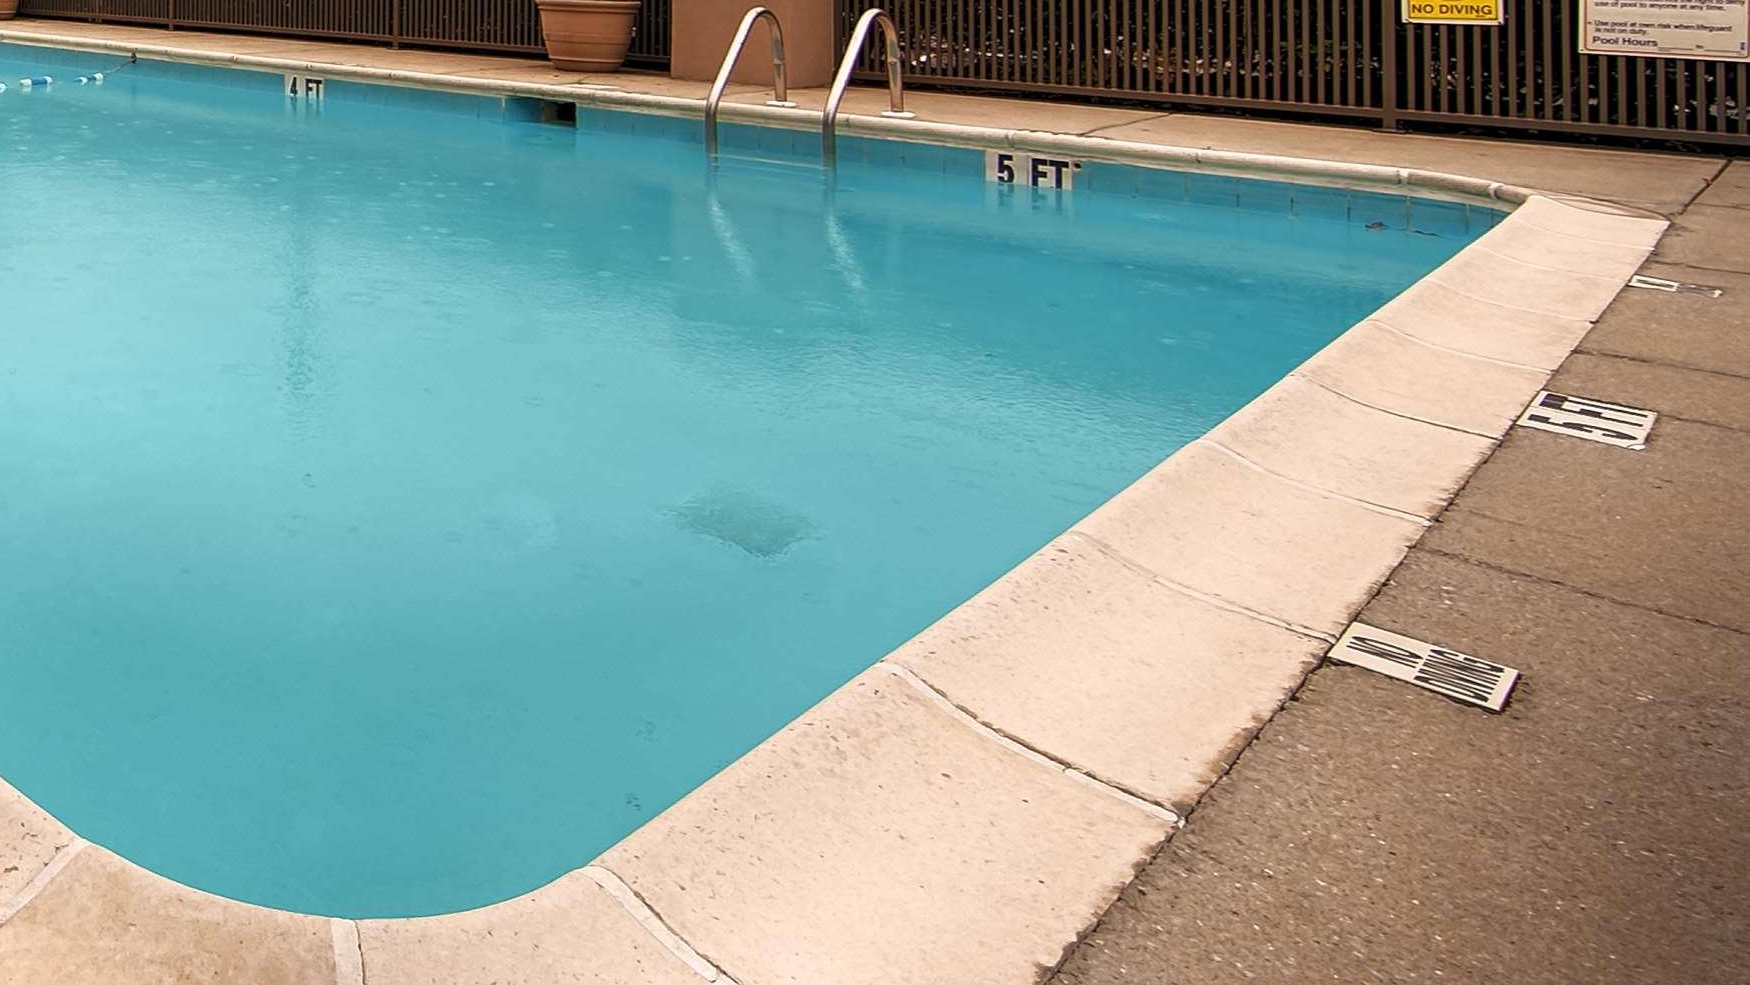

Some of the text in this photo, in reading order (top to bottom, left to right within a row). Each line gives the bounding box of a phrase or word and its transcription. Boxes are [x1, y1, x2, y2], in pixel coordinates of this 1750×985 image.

[1411, 3, 1493, 15] NO DIVING
[1592, 36, 1658, 47] Pool Hours
[290, 76, 323, 98] 4 FT
[997, 154, 1069, 189] 5 FT
[1527, 393, 1649, 440] 5 FT
[1346, 636, 1424, 669] NO
[1413, 649, 1505, 703] DIVING
